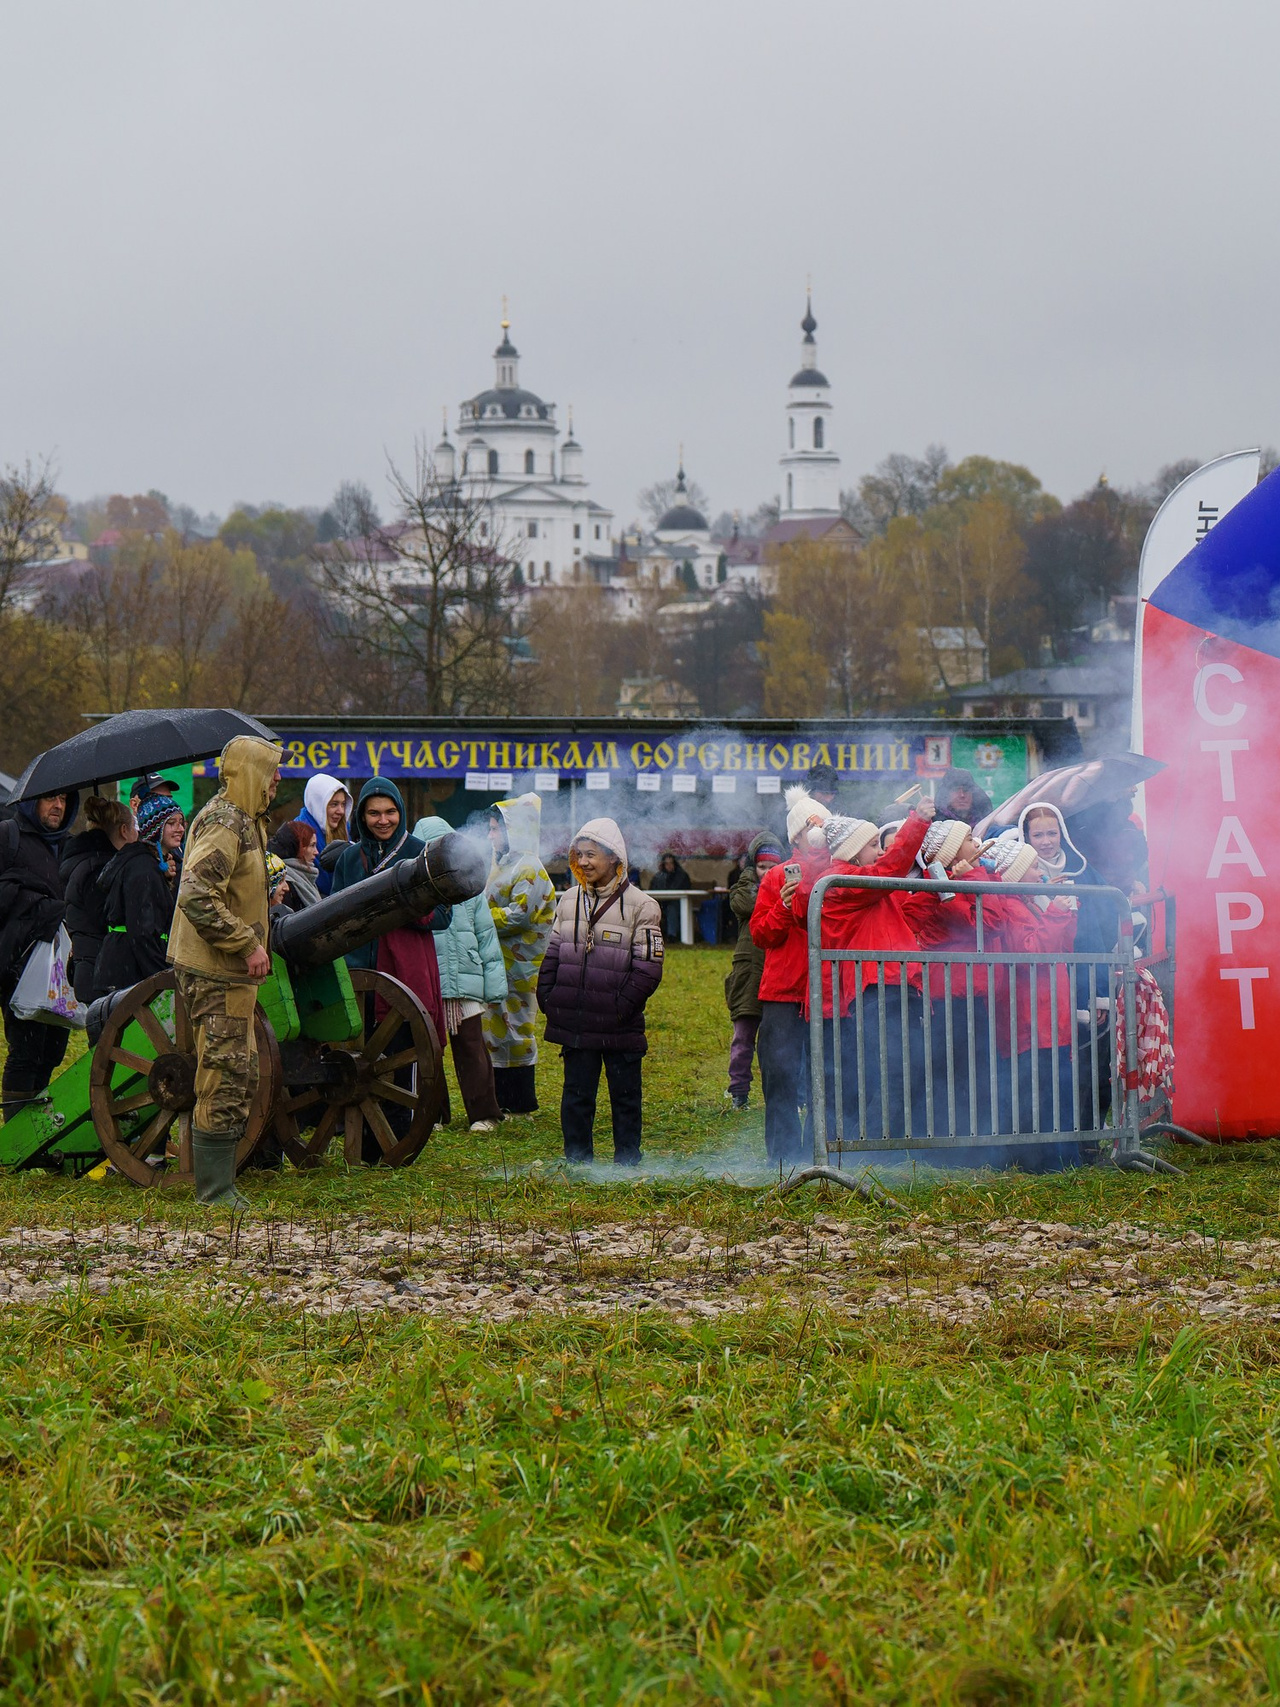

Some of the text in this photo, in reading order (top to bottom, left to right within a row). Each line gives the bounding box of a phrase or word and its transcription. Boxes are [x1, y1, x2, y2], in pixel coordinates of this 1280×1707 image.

[1195, 500, 1219, 544] НГ
[276, 738, 911, 777] ВЕТ УЧАСТНИКАМ СОРЕВНОВАНИЙ
[1193, 662, 1270, 1030] СТАРТ
